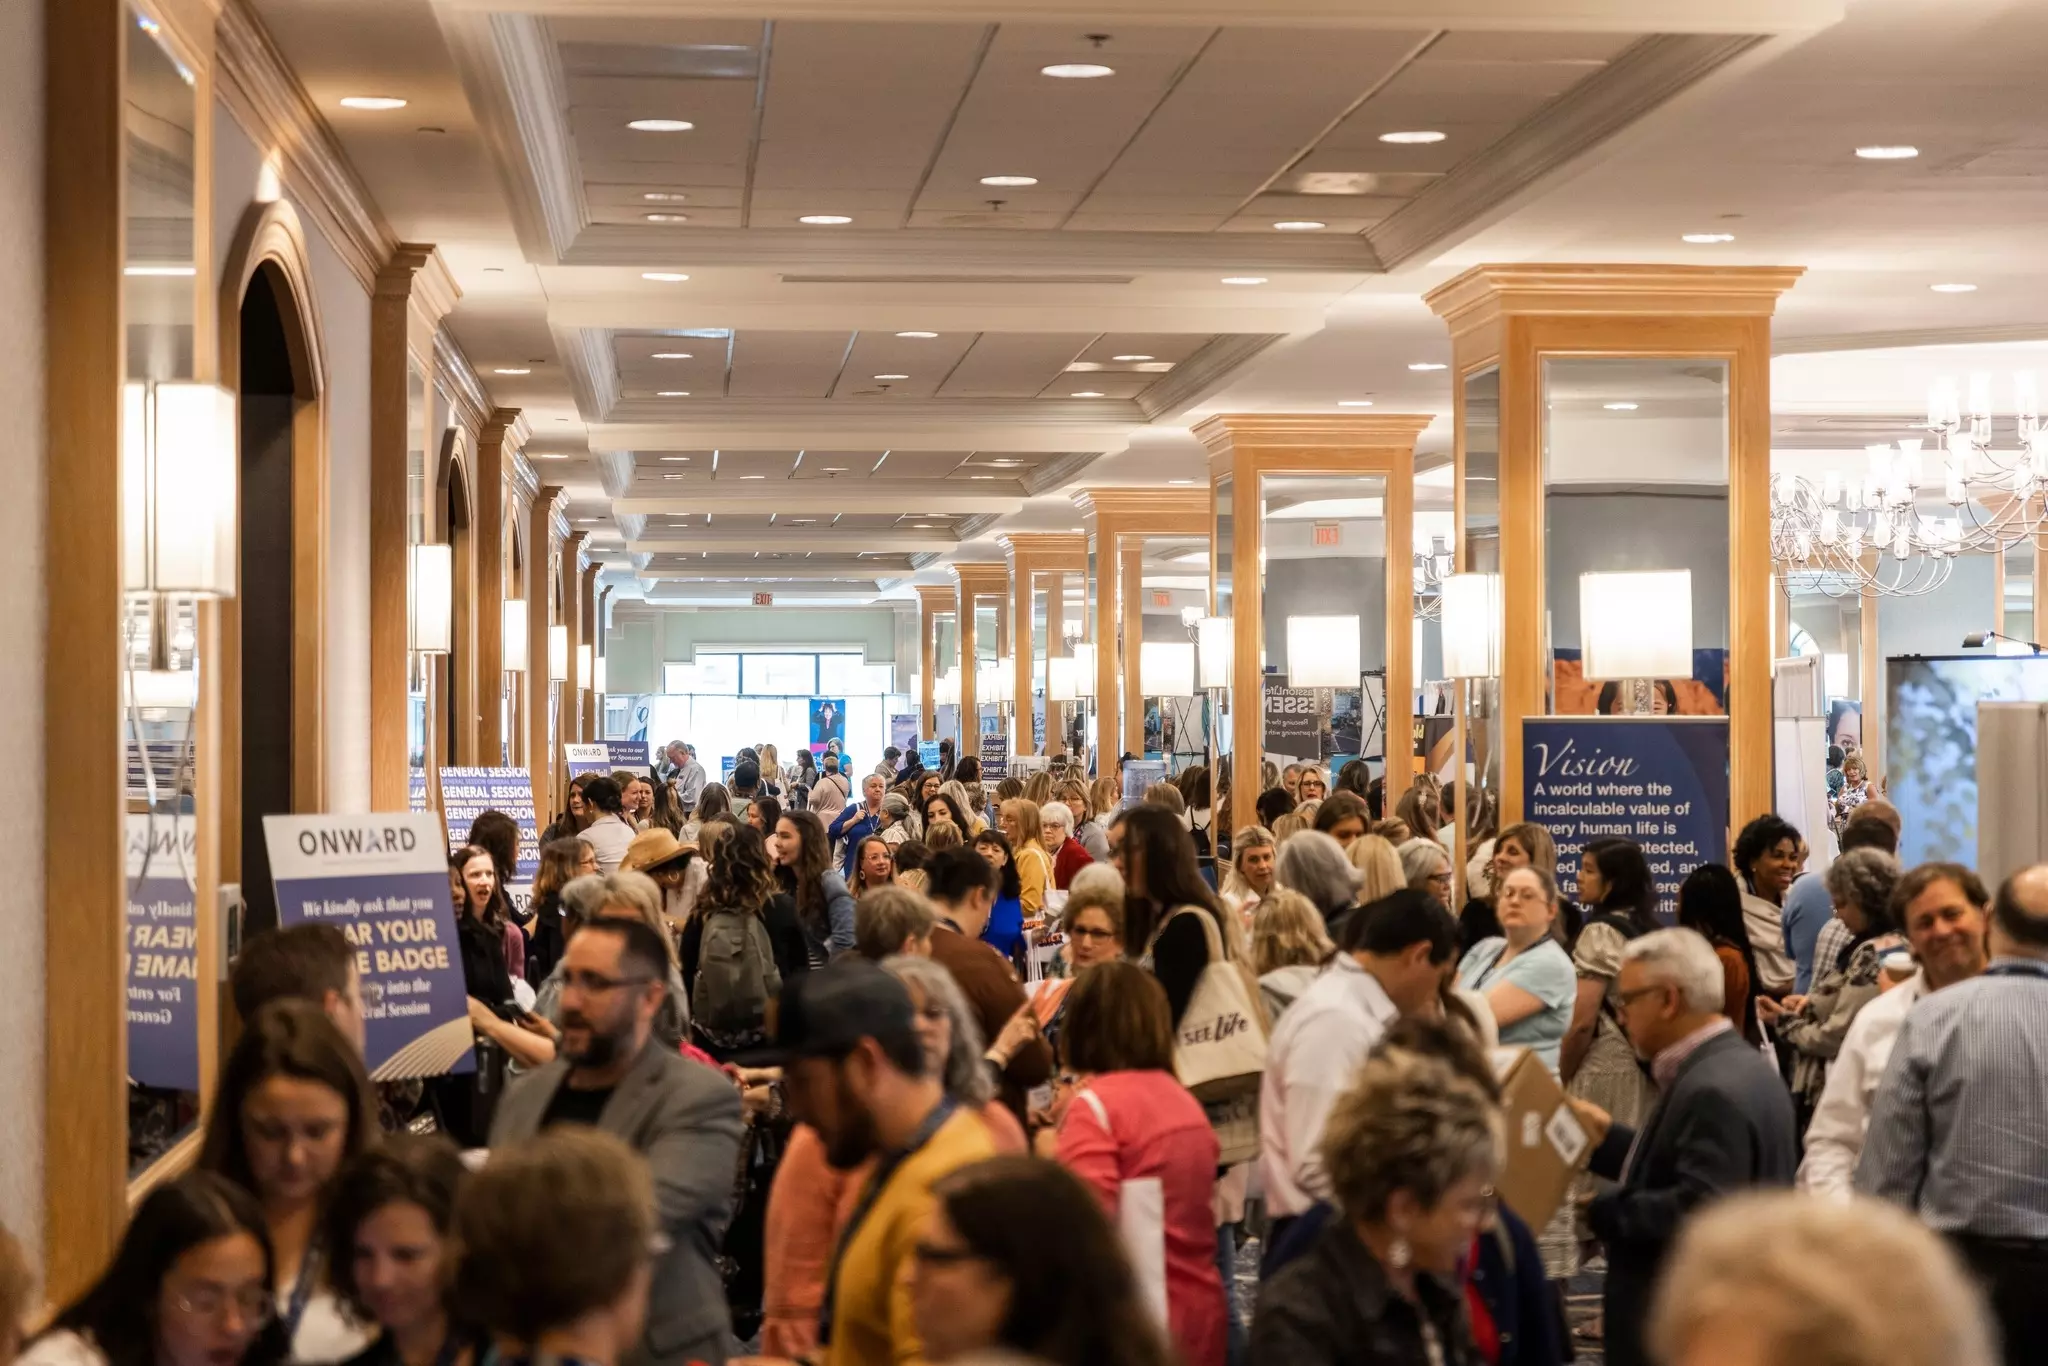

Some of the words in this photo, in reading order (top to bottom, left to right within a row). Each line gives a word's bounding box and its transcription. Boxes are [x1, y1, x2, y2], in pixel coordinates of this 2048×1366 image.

[755, 593, 771, 605] EXIT
[573, 748, 601, 756] ONWARD
[618, 754, 643, 762] Sponsors
[1532, 738, 1640, 777] Vision
[440, 767, 487, 778] GENERAL
[488, 767, 530, 778] SESSION
[443, 786, 490, 798] GENERAL
[491, 786, 533, 798] SESSION
[1534, 783, 1545, 796] A
[1551, 782, 1592, 796] world
[1596, 782, 1643, 796] where
[1647, 782, 1673, 796] the
[1534, 802, 1625, 816] incalculable
[1629, 803, 1670, 816] value
[1675, 802, 1690, 816] of
[1580, 822, 1632, 835] human
[1636, 822, 1659, 835] life
[1663, 822, 1677, 835] is
[298, 827, 417, 856] ONWARD
[1640, 841, 1699, 856] otected,
[517, 849, 541, 861] SION
[303, 901, 321, 917] We
[323, 898, 361, 918] kindly
[363, 897, 385, 915] ask
[386, 896, 410, 912] that
[412, 898, 434, 915] you
[344, 921, 373, 947] AR
[375, 918, 438, 945] YOUR
[375, 946, 450, 974] BADGE
[386, 980, 411, 994] into
[412, 977, 432, 993] the
[387, 1001, 431, 1018] Session
[1183, 1027, 1212, 1046] SEE
[1214, 1011, 1249, 1043] Life
